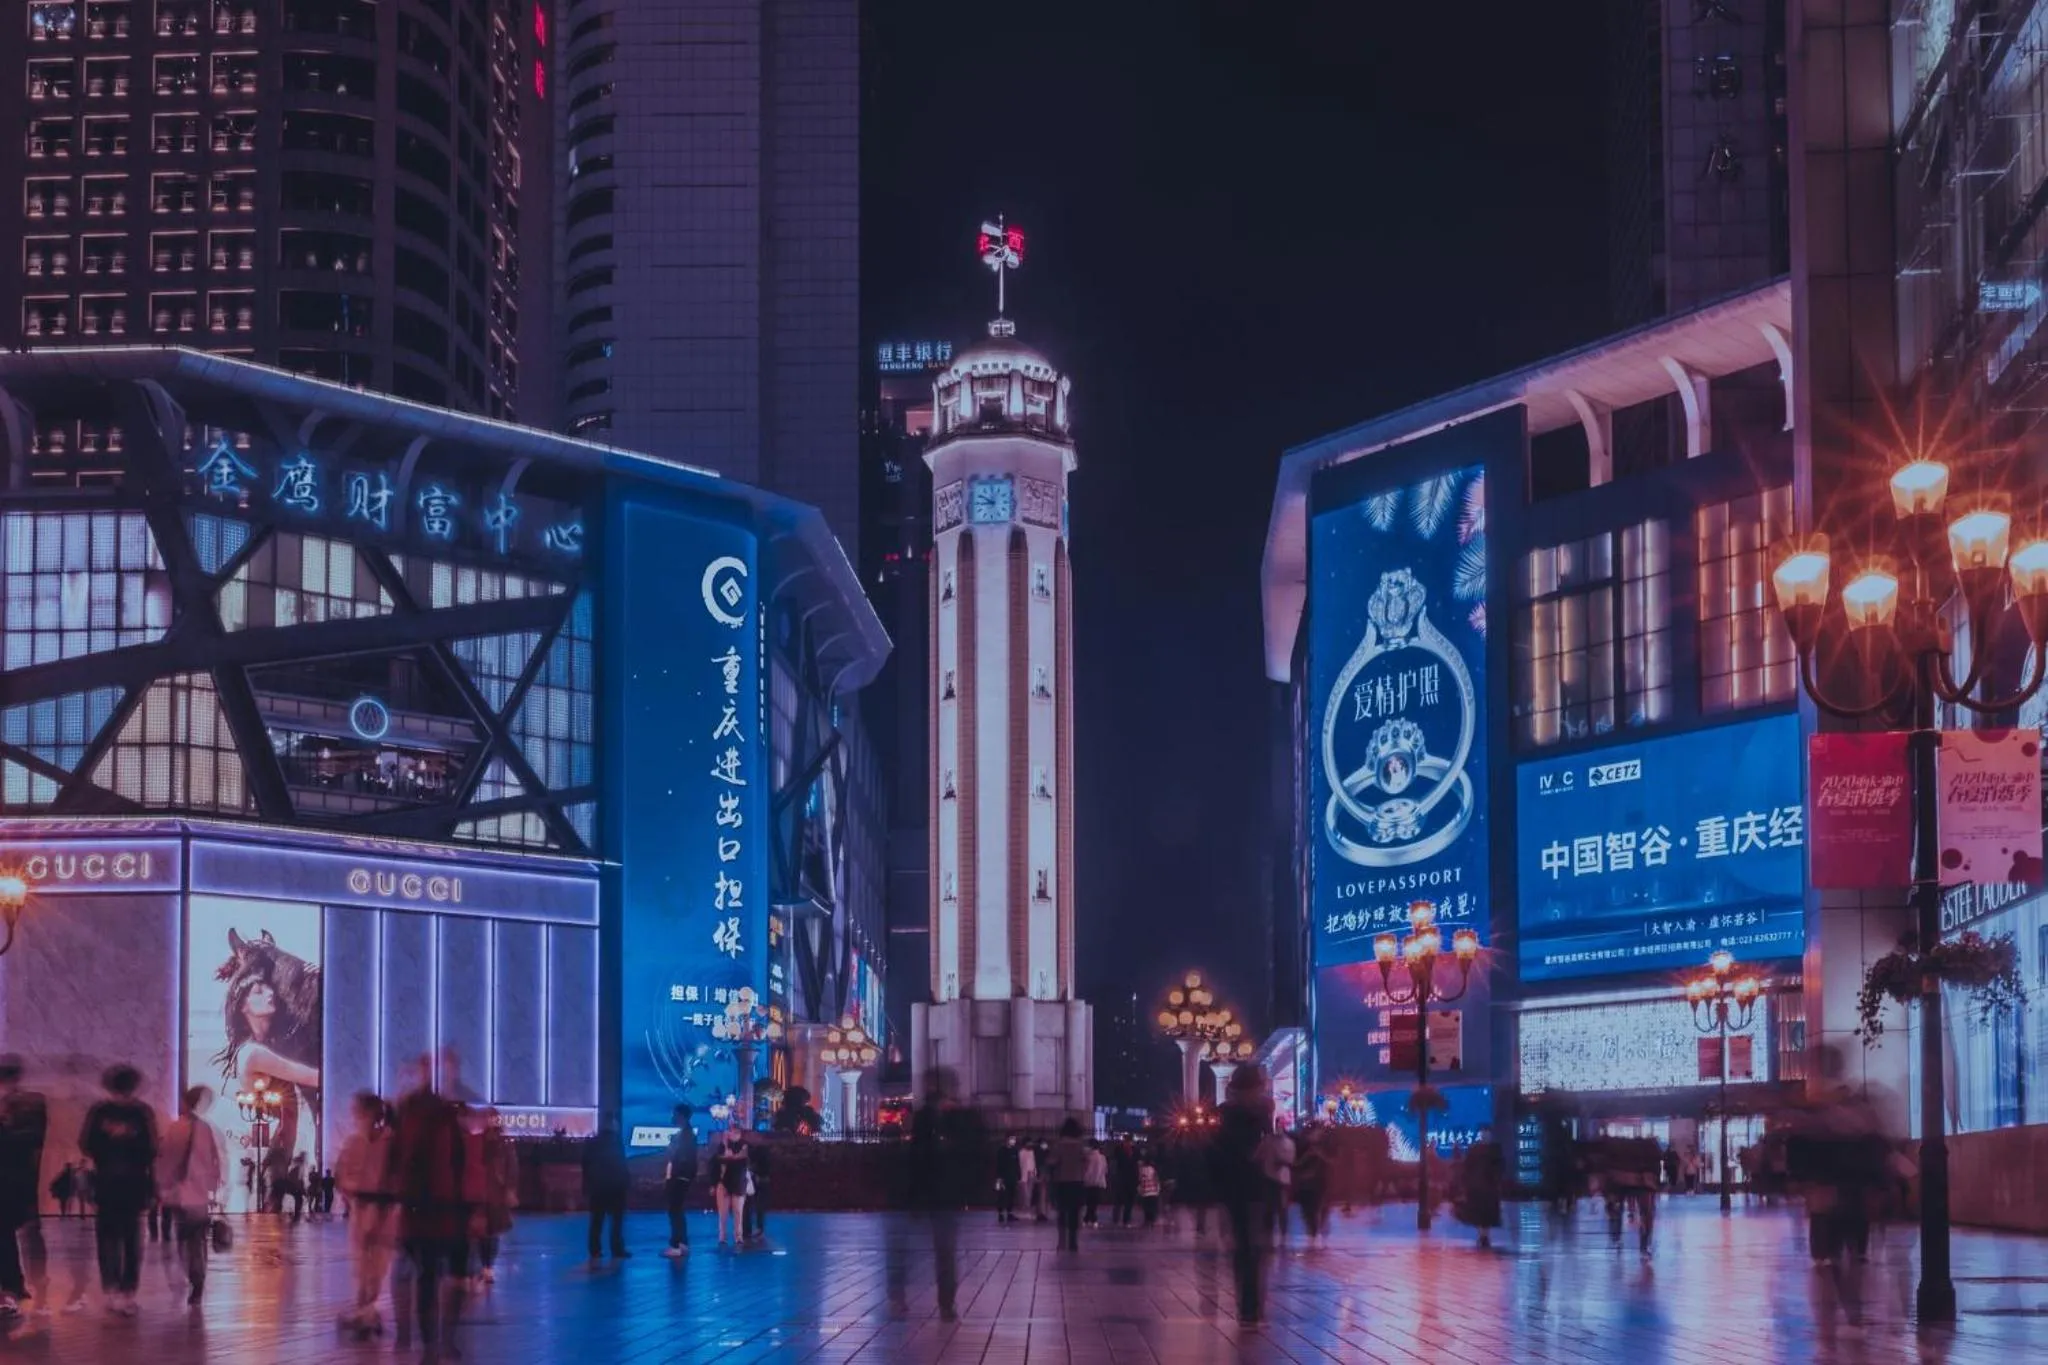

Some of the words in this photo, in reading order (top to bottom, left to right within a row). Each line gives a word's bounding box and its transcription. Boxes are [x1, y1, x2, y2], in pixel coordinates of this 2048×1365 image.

[199, 437, 584, 555] 金鹰财富中心
[1354, 663, 1440, 722] 爱情护照
[1606, 763, 1639, 781] CETZ
[710, 645, 747, 960] 重庆进出口担保
[25, 853, 151, 880] GUCCI
[348, 869, 461, 902] GUCCI
[1336, 867, 1462, 899] LOVEPASSPORT
[670, 984, 699, 1002] 担保
